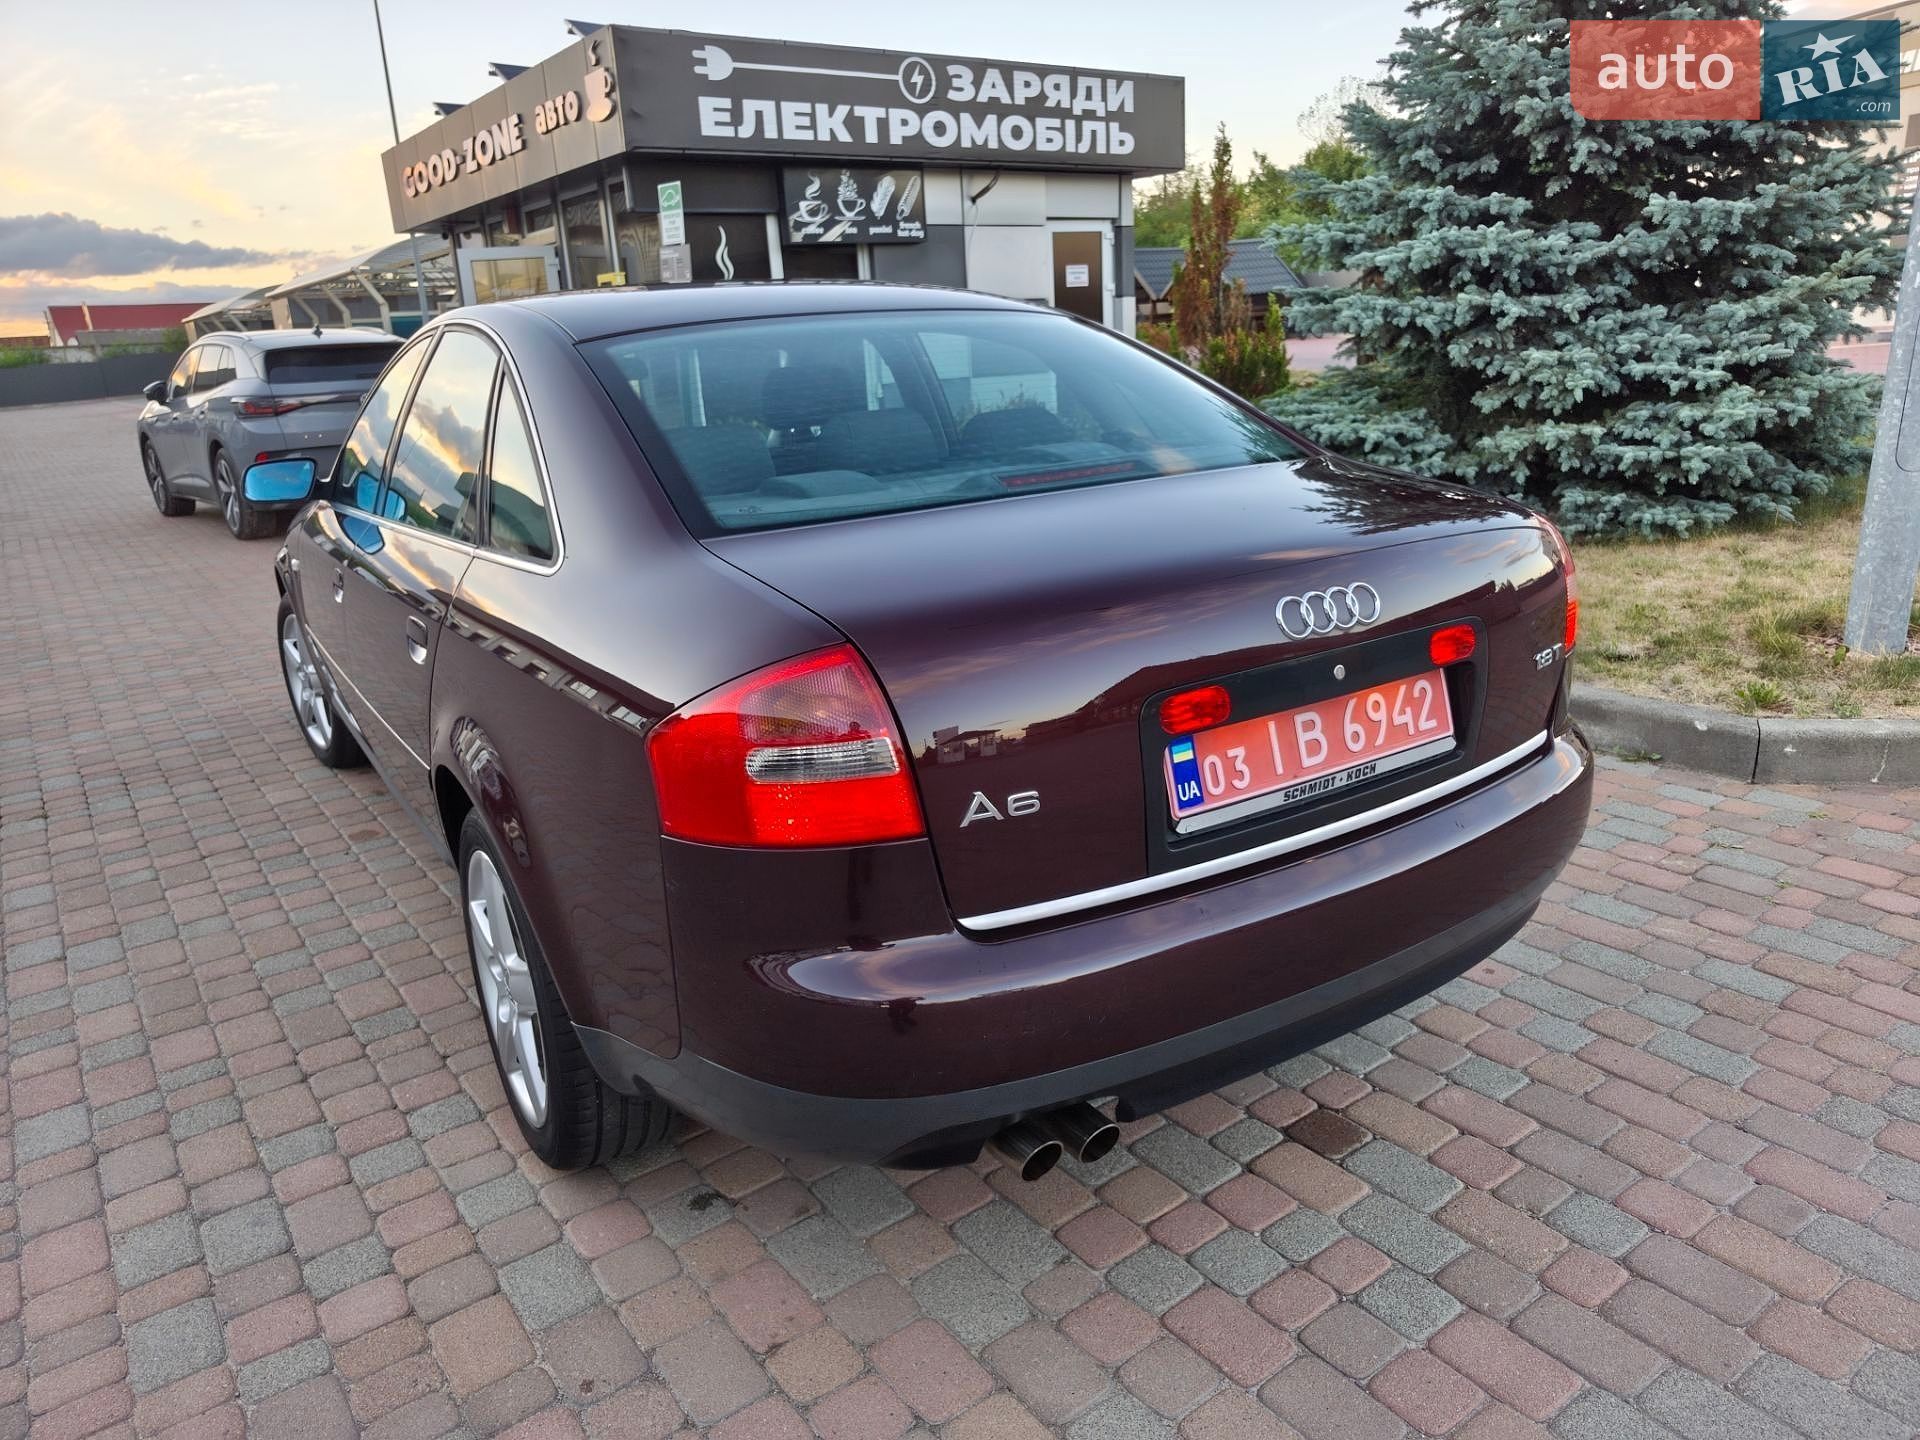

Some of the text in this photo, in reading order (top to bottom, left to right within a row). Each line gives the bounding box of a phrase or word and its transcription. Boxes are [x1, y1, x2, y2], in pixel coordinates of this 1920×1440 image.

[945, 64, 1136, 117] ЗАРЯДИ
[402, 90, 581, 198] GOOD-ZONE авто
[697, 95, 1136, 155] ЕЛЕКТРОМОБІЛЬ
[1203, 745, 1251, 796] 03
[1343, 678, 1440, 754] 6942
[1177, 780, 1201, 801] UA
[1283, 763, 1377, 802] SCHMIDT KOCH
[960, 791, 1041, 828] A6
